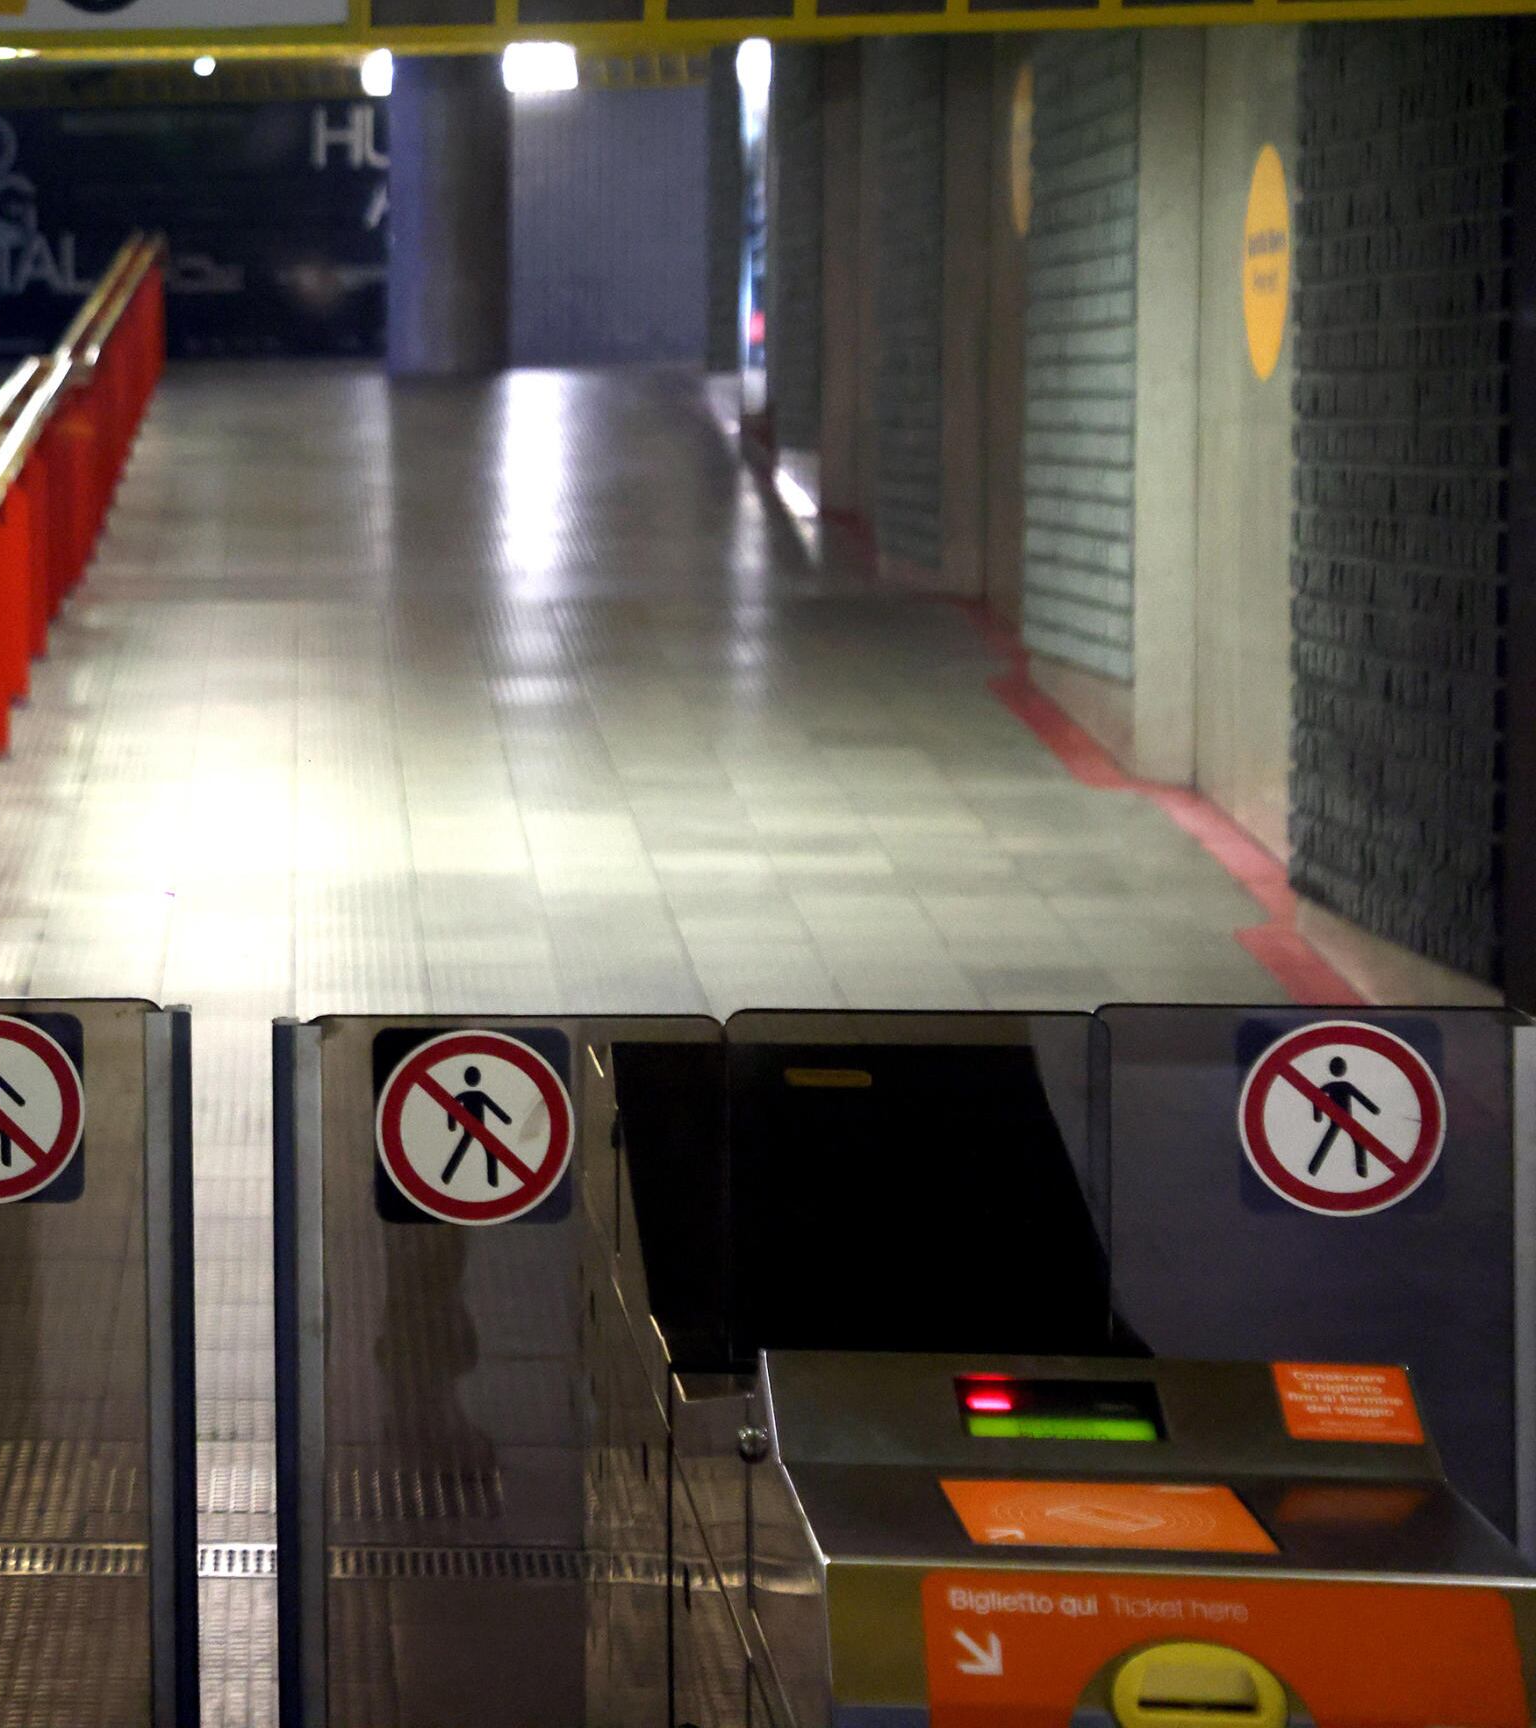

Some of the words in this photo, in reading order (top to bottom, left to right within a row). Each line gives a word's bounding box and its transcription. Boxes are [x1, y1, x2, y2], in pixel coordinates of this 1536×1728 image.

[1291, 1370, 1386, 1384] Conservare
[948, 1587, 1054, 1615] Biglietto
[1060, 1593, 1099, 1617] qui
[1109, 1594, 1184, 1620] Ticket
[1191, 1597, 1249, 1623] here
